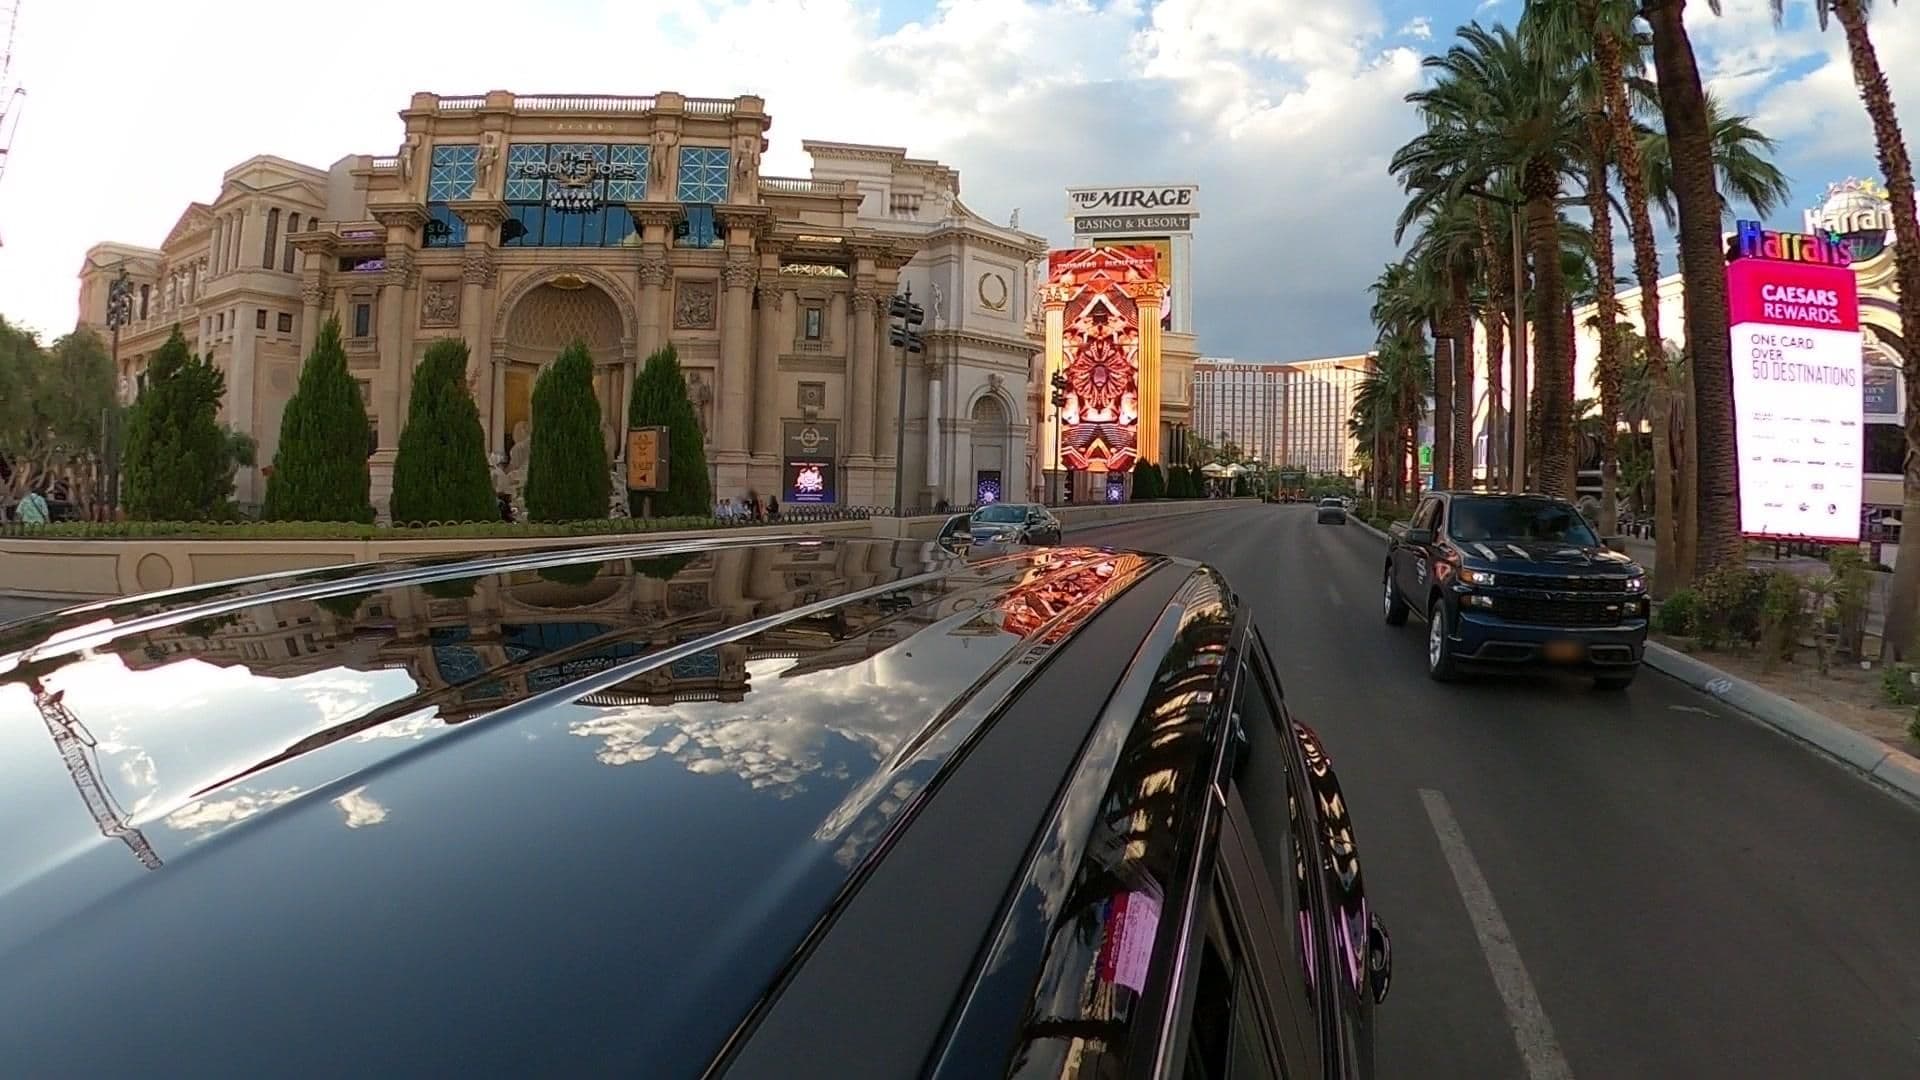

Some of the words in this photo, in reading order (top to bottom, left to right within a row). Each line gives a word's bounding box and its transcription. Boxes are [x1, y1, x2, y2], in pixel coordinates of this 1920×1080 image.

[561, 152, 592, 160] THE
[516, 162, 574, 174] FORUM
[576, 163, 636, 175] SHOPS
[1072, 192, 1098, 202] THE
[1081, 189, 1191, 209] MIRAGE
[1076, 219, 1122, 230] CASINO
[1125, 219, 1135, 228] &
[1137, 217, 1187, 228] RESORT
[1761, 284, 1839, 307] CAESARS
[1763, 302, 1840, 324] REWARDS
[1751, 333, 1777, 346] ONE
[1780, 336, 1814, 350] CARD
[1751, 348, 1784, 361] OVER
[1752, 360, 1769, 380] 50
[1772, 361, 1856, 387] DESTINATIONS
